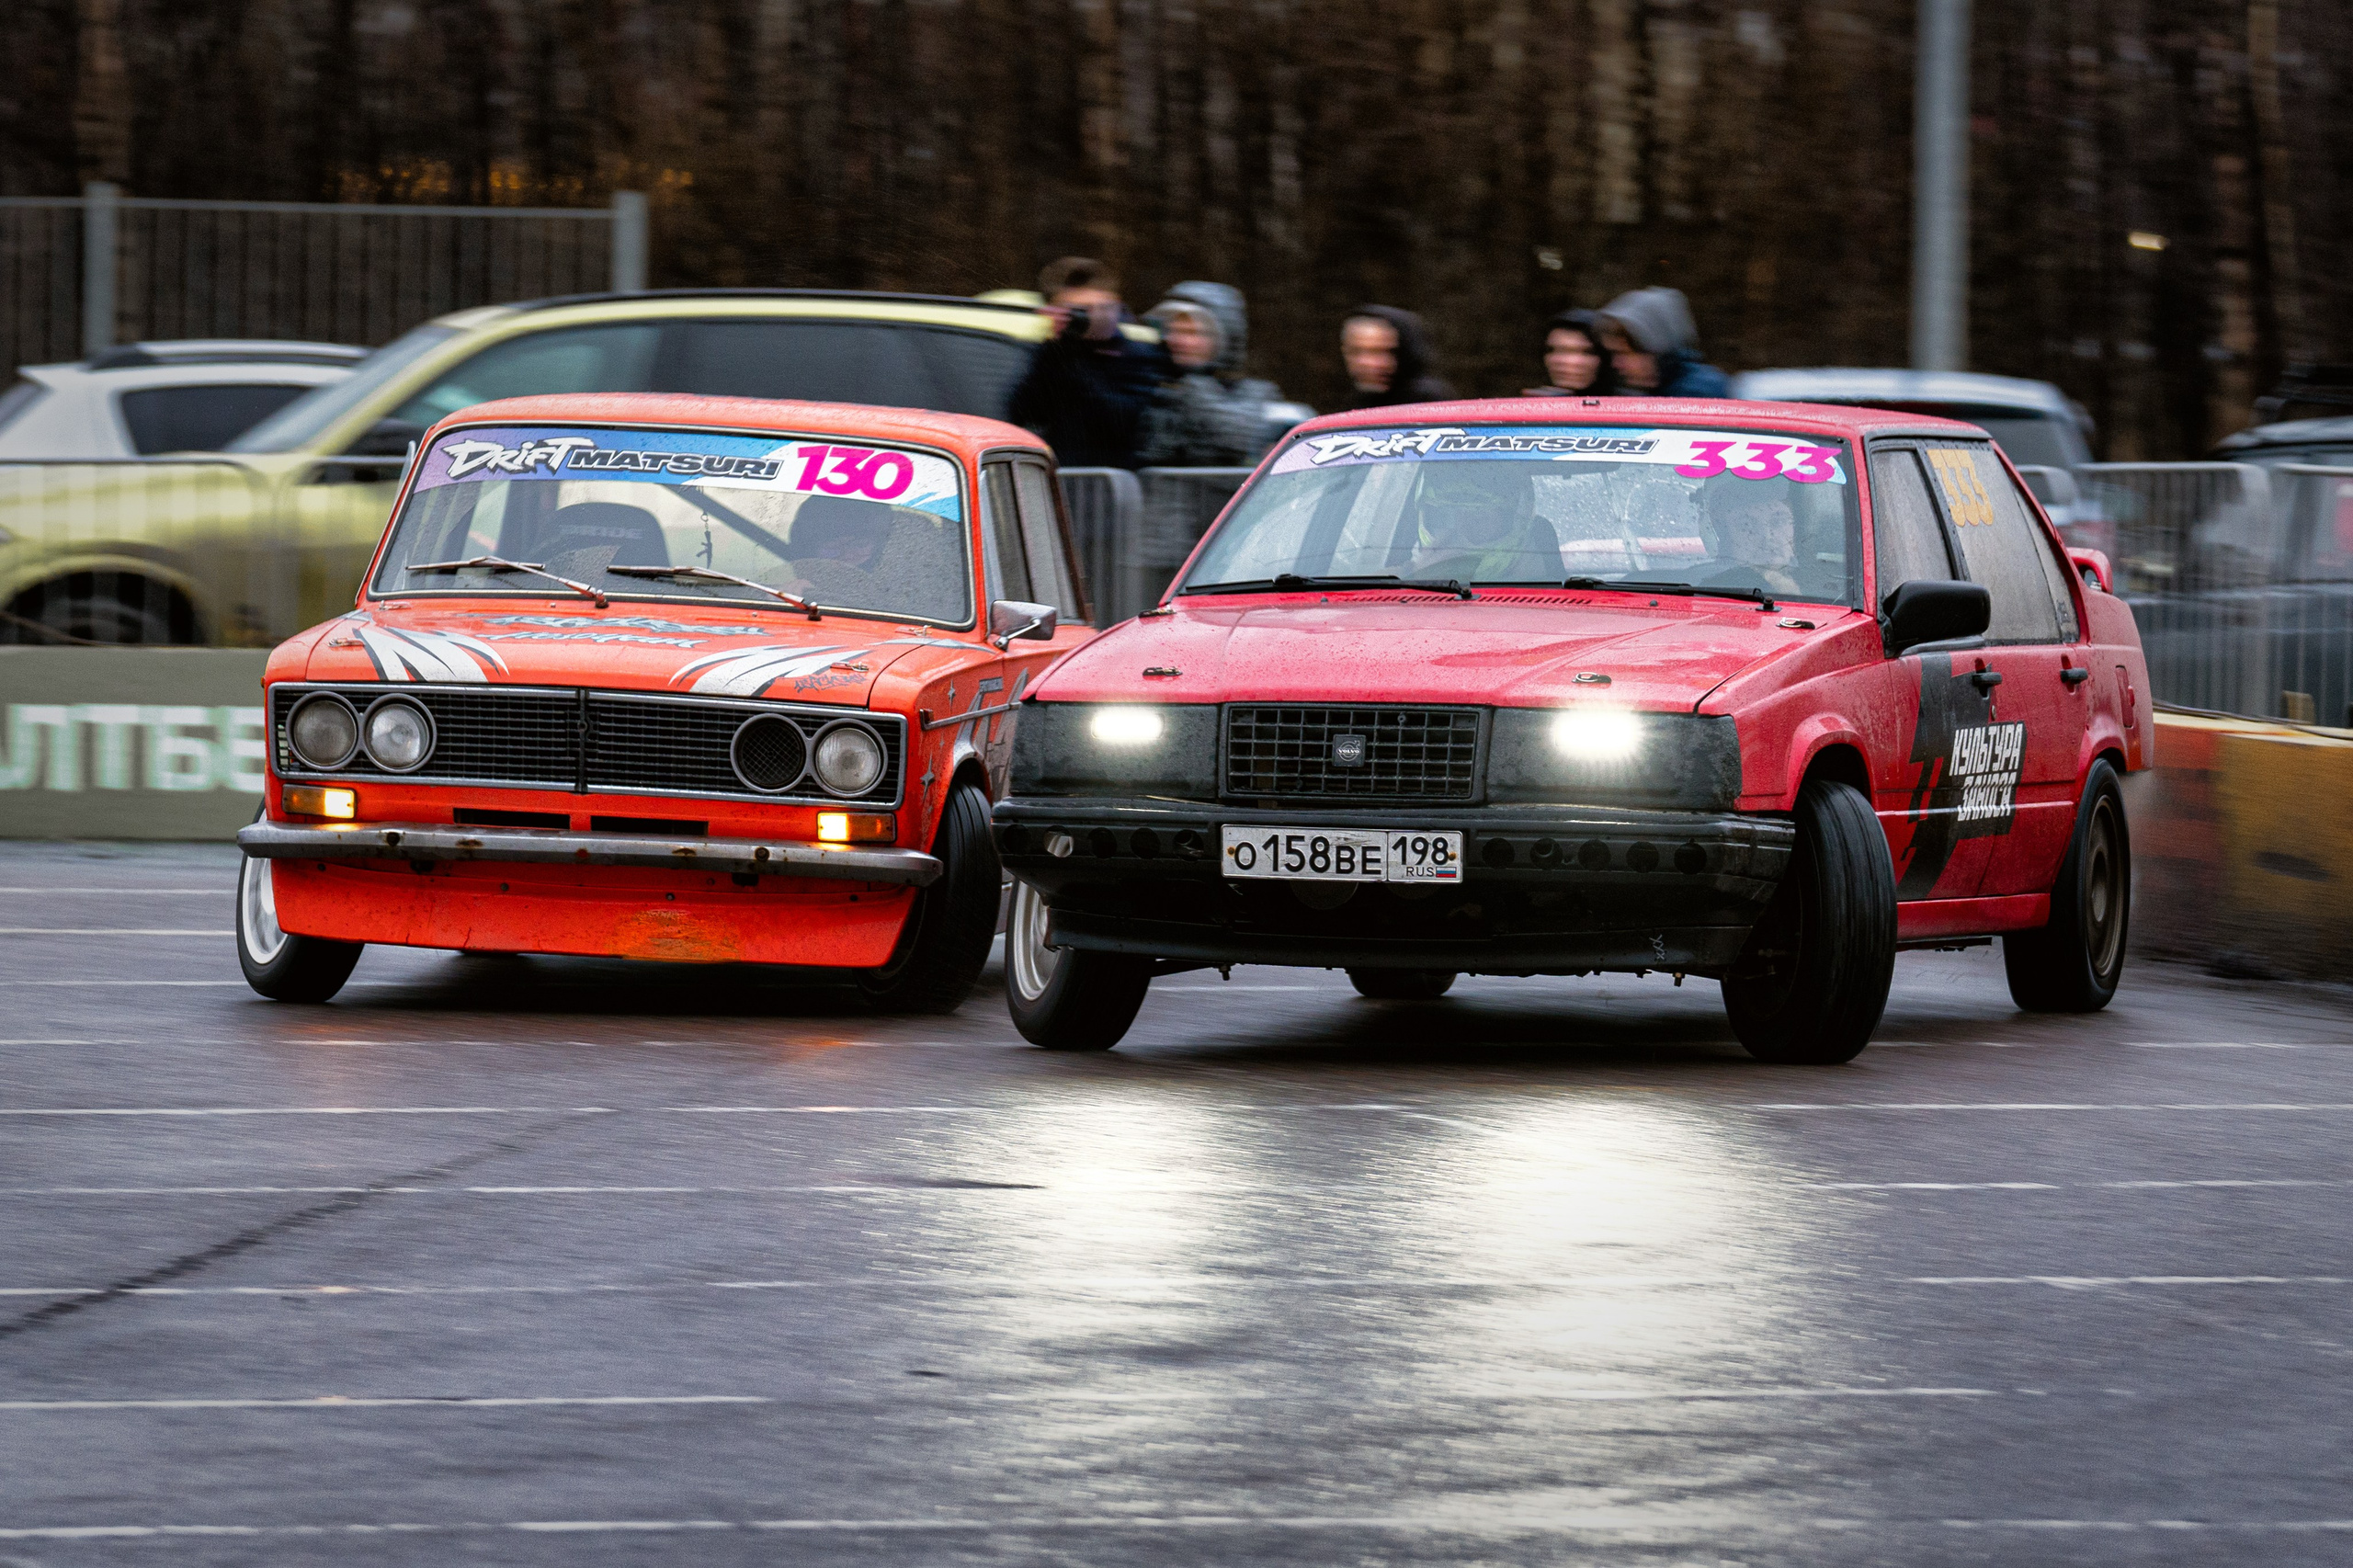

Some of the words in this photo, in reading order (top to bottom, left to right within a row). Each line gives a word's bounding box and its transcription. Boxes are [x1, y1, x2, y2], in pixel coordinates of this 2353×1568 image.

[565, 448, 784, 481] MATSURI
[795, 444, 915, 501] 130
[1435, 435, 1659, 456] MATSURI
[1674, 440, 1843, 484] 333
[1927, 449, 1994, 528] 333
[1949, 722, 2023, 776] КУЛЬТУРА
[1392, 835, 1449, 866] 198
[1405, 866, 1435, 877] RUS
